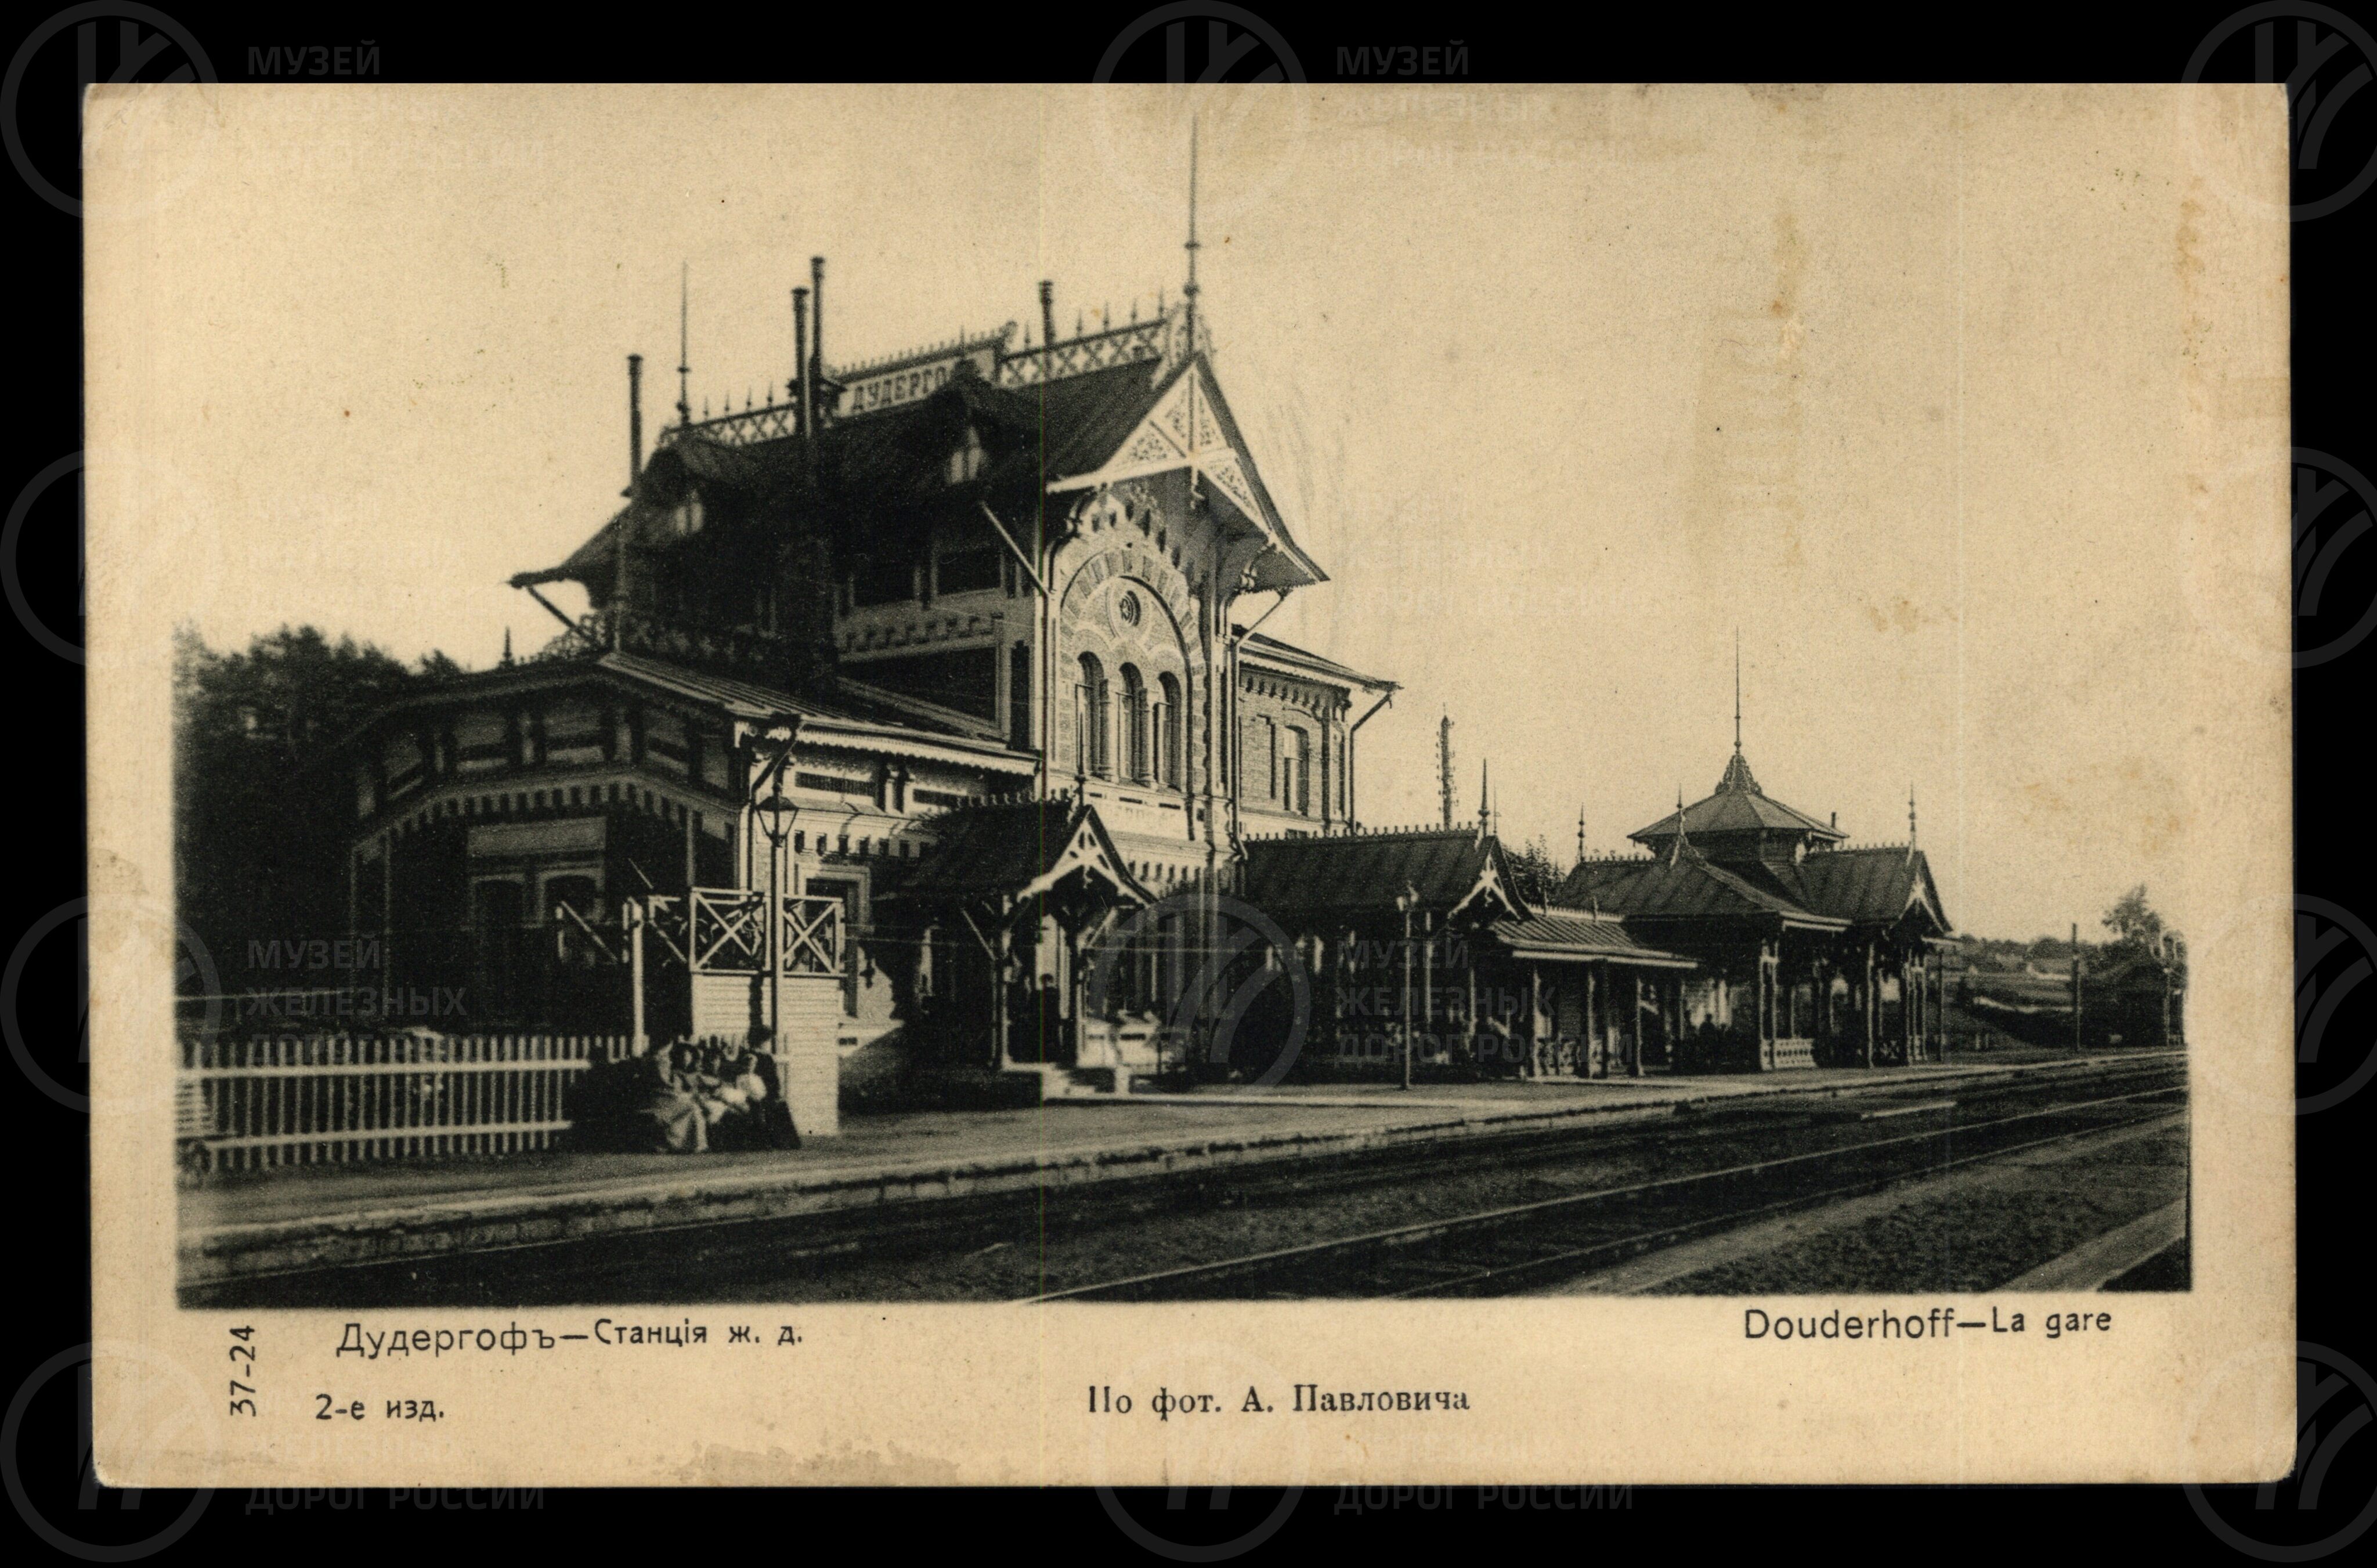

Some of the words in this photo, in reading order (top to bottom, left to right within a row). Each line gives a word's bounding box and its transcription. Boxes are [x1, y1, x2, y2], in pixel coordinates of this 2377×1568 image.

[853, 365, 948, 410] ДУДЕРГО
[728, 1325, 760, 1344] ж.
[778, 1325, 803, 1346] д.
[2046, 1312, 2113, 1340] gare
[229, 1325, 258, 1418] 37-24
[316, 1393, 366, 1421] 2-е
[386, 1399, 445, 1423] изд.
[1151, 1386, 1222, 1422] фот.
[1293, 1384, 1471, 1412] Павловича
